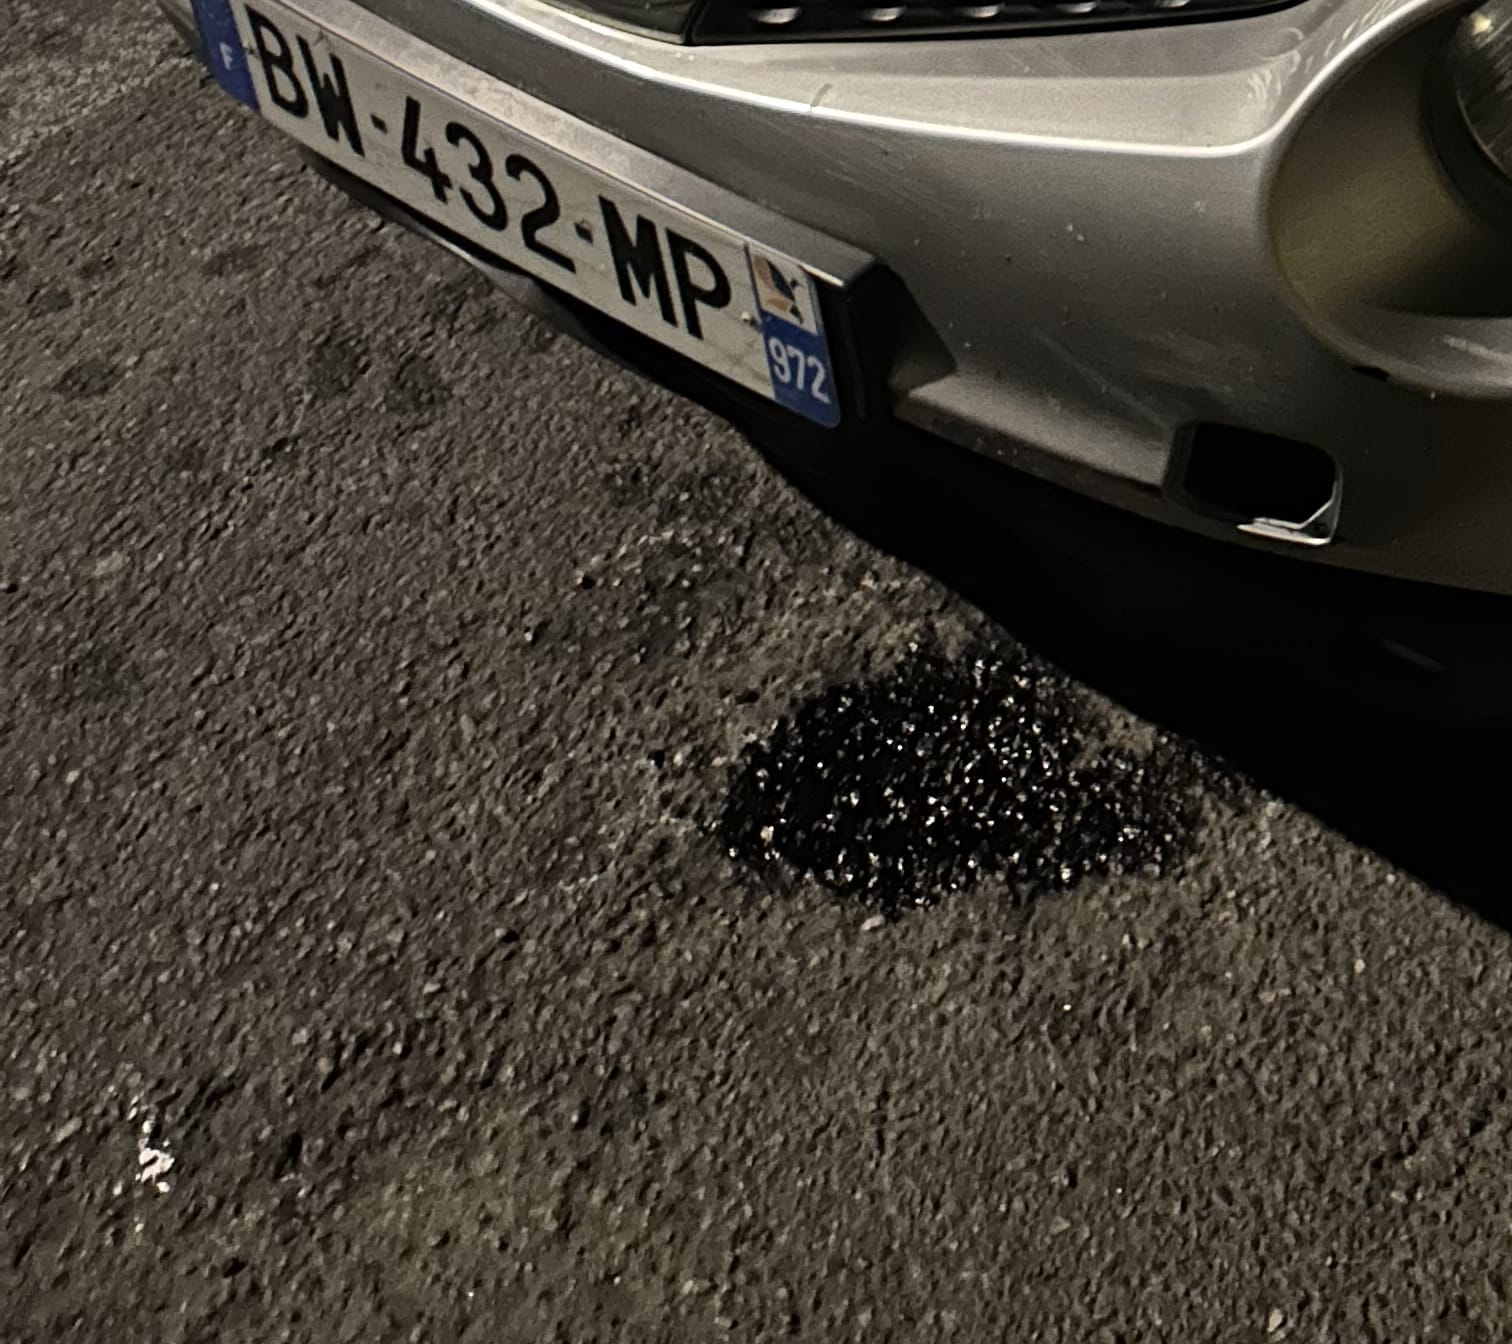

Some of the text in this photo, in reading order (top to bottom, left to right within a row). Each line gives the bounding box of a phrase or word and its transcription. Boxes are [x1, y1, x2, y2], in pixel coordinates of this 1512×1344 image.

[219, 42, 233, 71] F
[245, 4, 732, 340] BW-432-MP
[768, 337, 831, 404] 972
